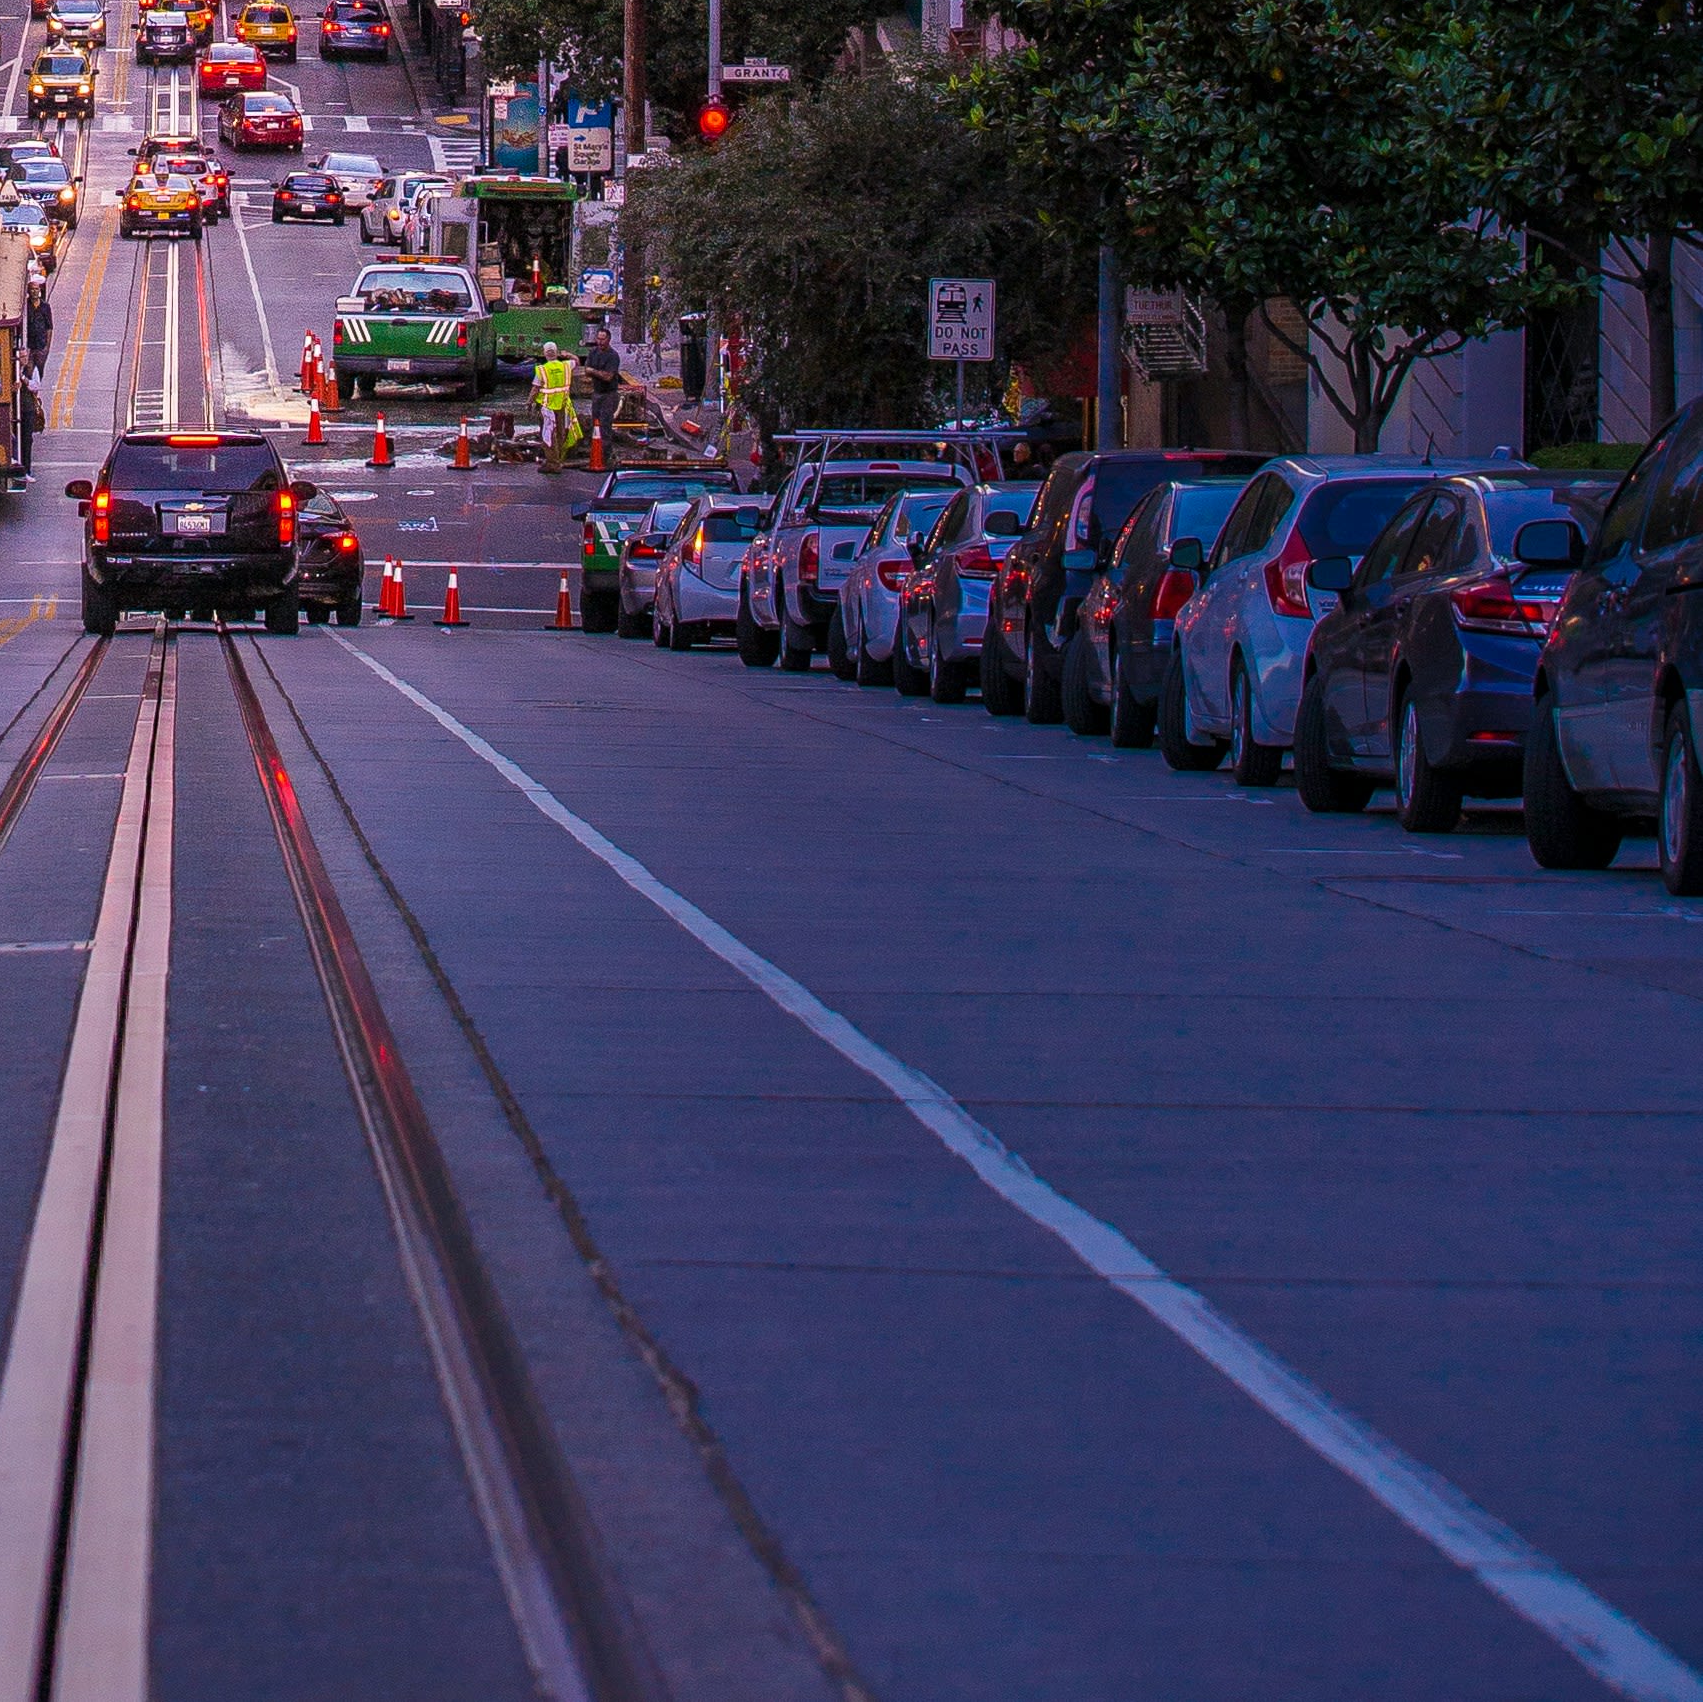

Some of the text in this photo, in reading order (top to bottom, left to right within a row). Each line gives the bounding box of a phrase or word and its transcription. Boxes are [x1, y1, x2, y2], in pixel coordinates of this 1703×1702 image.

[734, 68, 777, 77] GRANT
[935, 326, 987, 340] DO NOT
[943, 342, 979, 355] PASS
